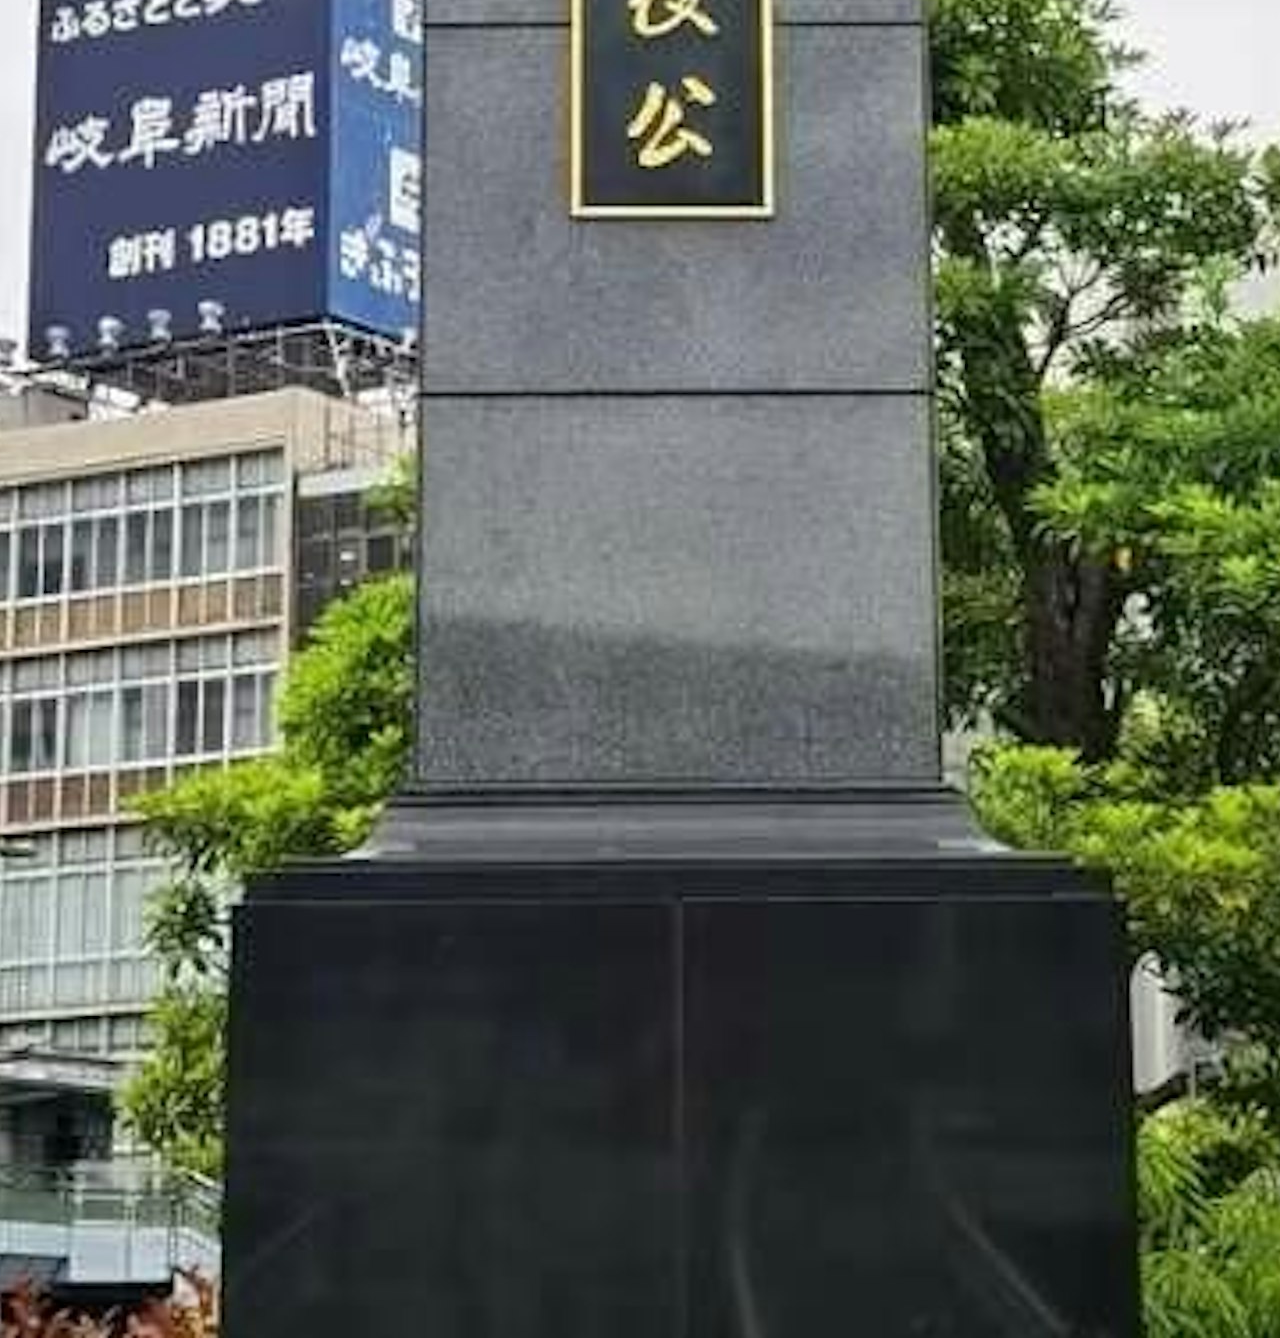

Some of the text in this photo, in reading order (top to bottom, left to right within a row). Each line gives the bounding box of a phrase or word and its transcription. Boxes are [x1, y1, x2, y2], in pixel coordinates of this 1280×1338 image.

[45, 71, 317, 174] 岐阜新聞
[108, 207, 316, 279] 創刊 1881年
